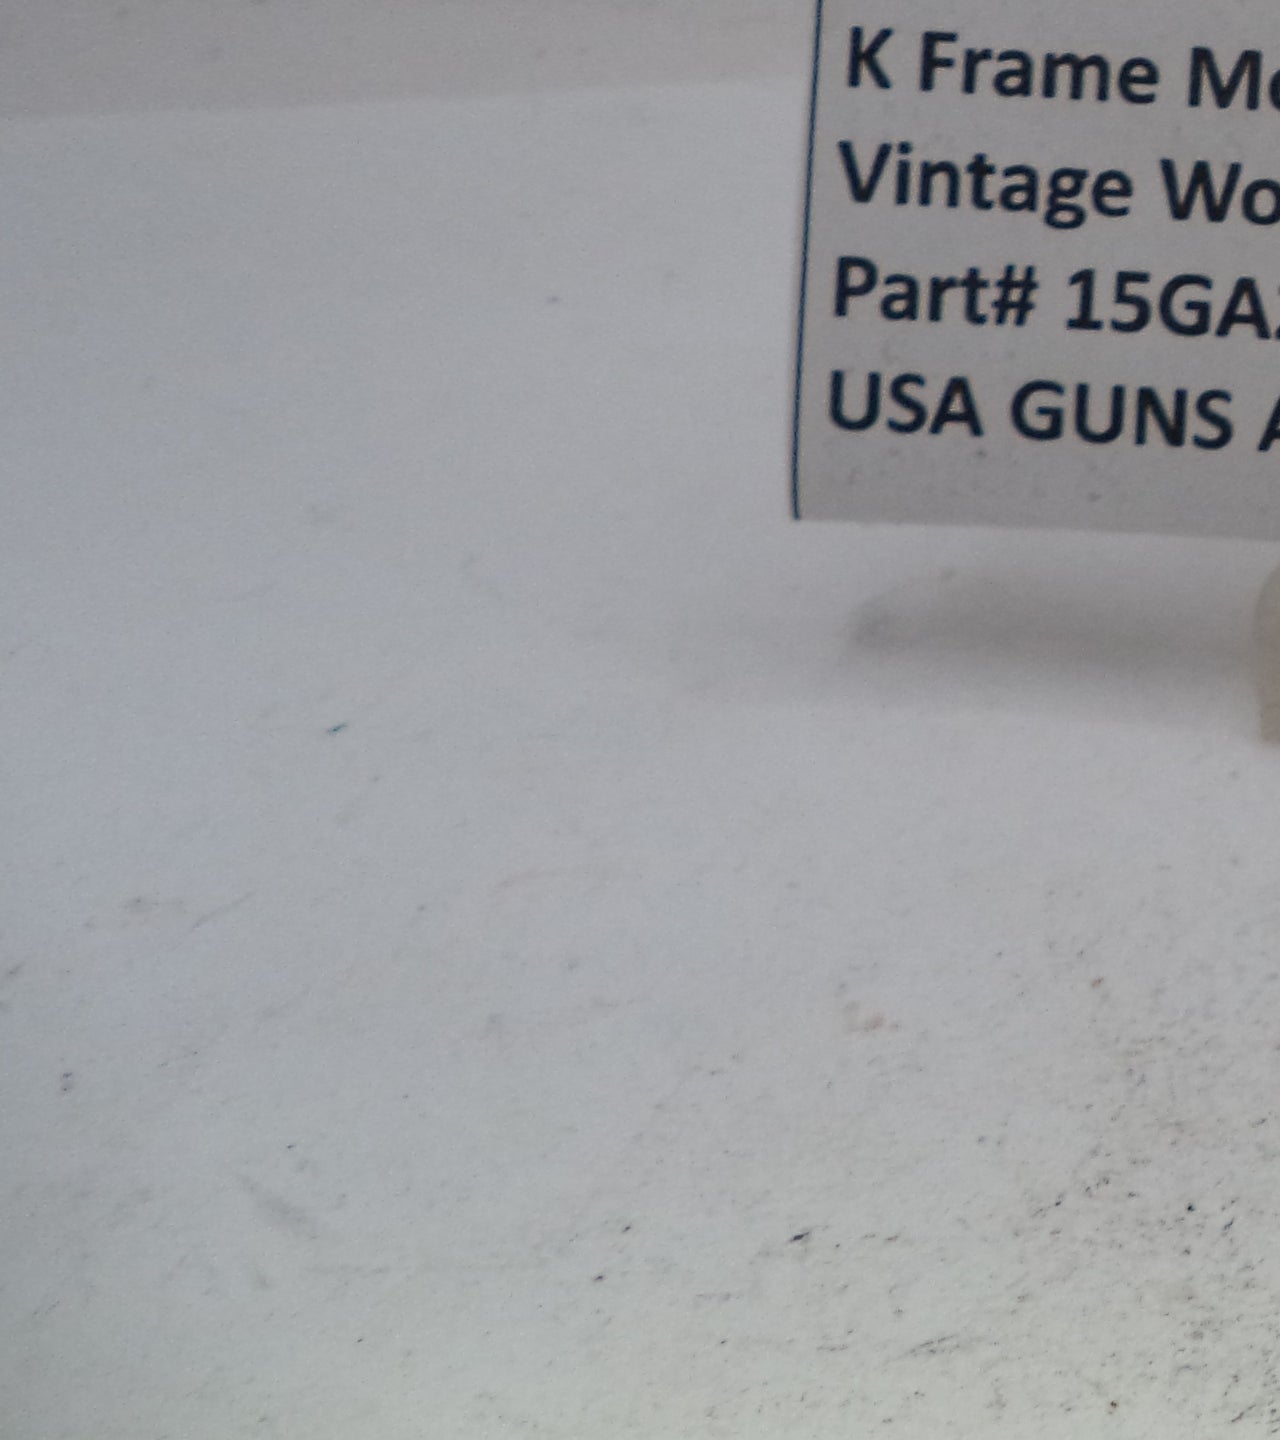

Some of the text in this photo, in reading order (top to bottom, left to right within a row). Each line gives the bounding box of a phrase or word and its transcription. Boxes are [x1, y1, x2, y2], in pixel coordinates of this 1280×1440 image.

[846, 24, 895, 91] K
[918, 29, 1161, 106] Frame
[836, 139, 1135, 232] Vintage
[832, 254, 1040, 328] Part#
[827, 368, 986, 439] USA
[1009, 378, 1235, 452] GUNS
